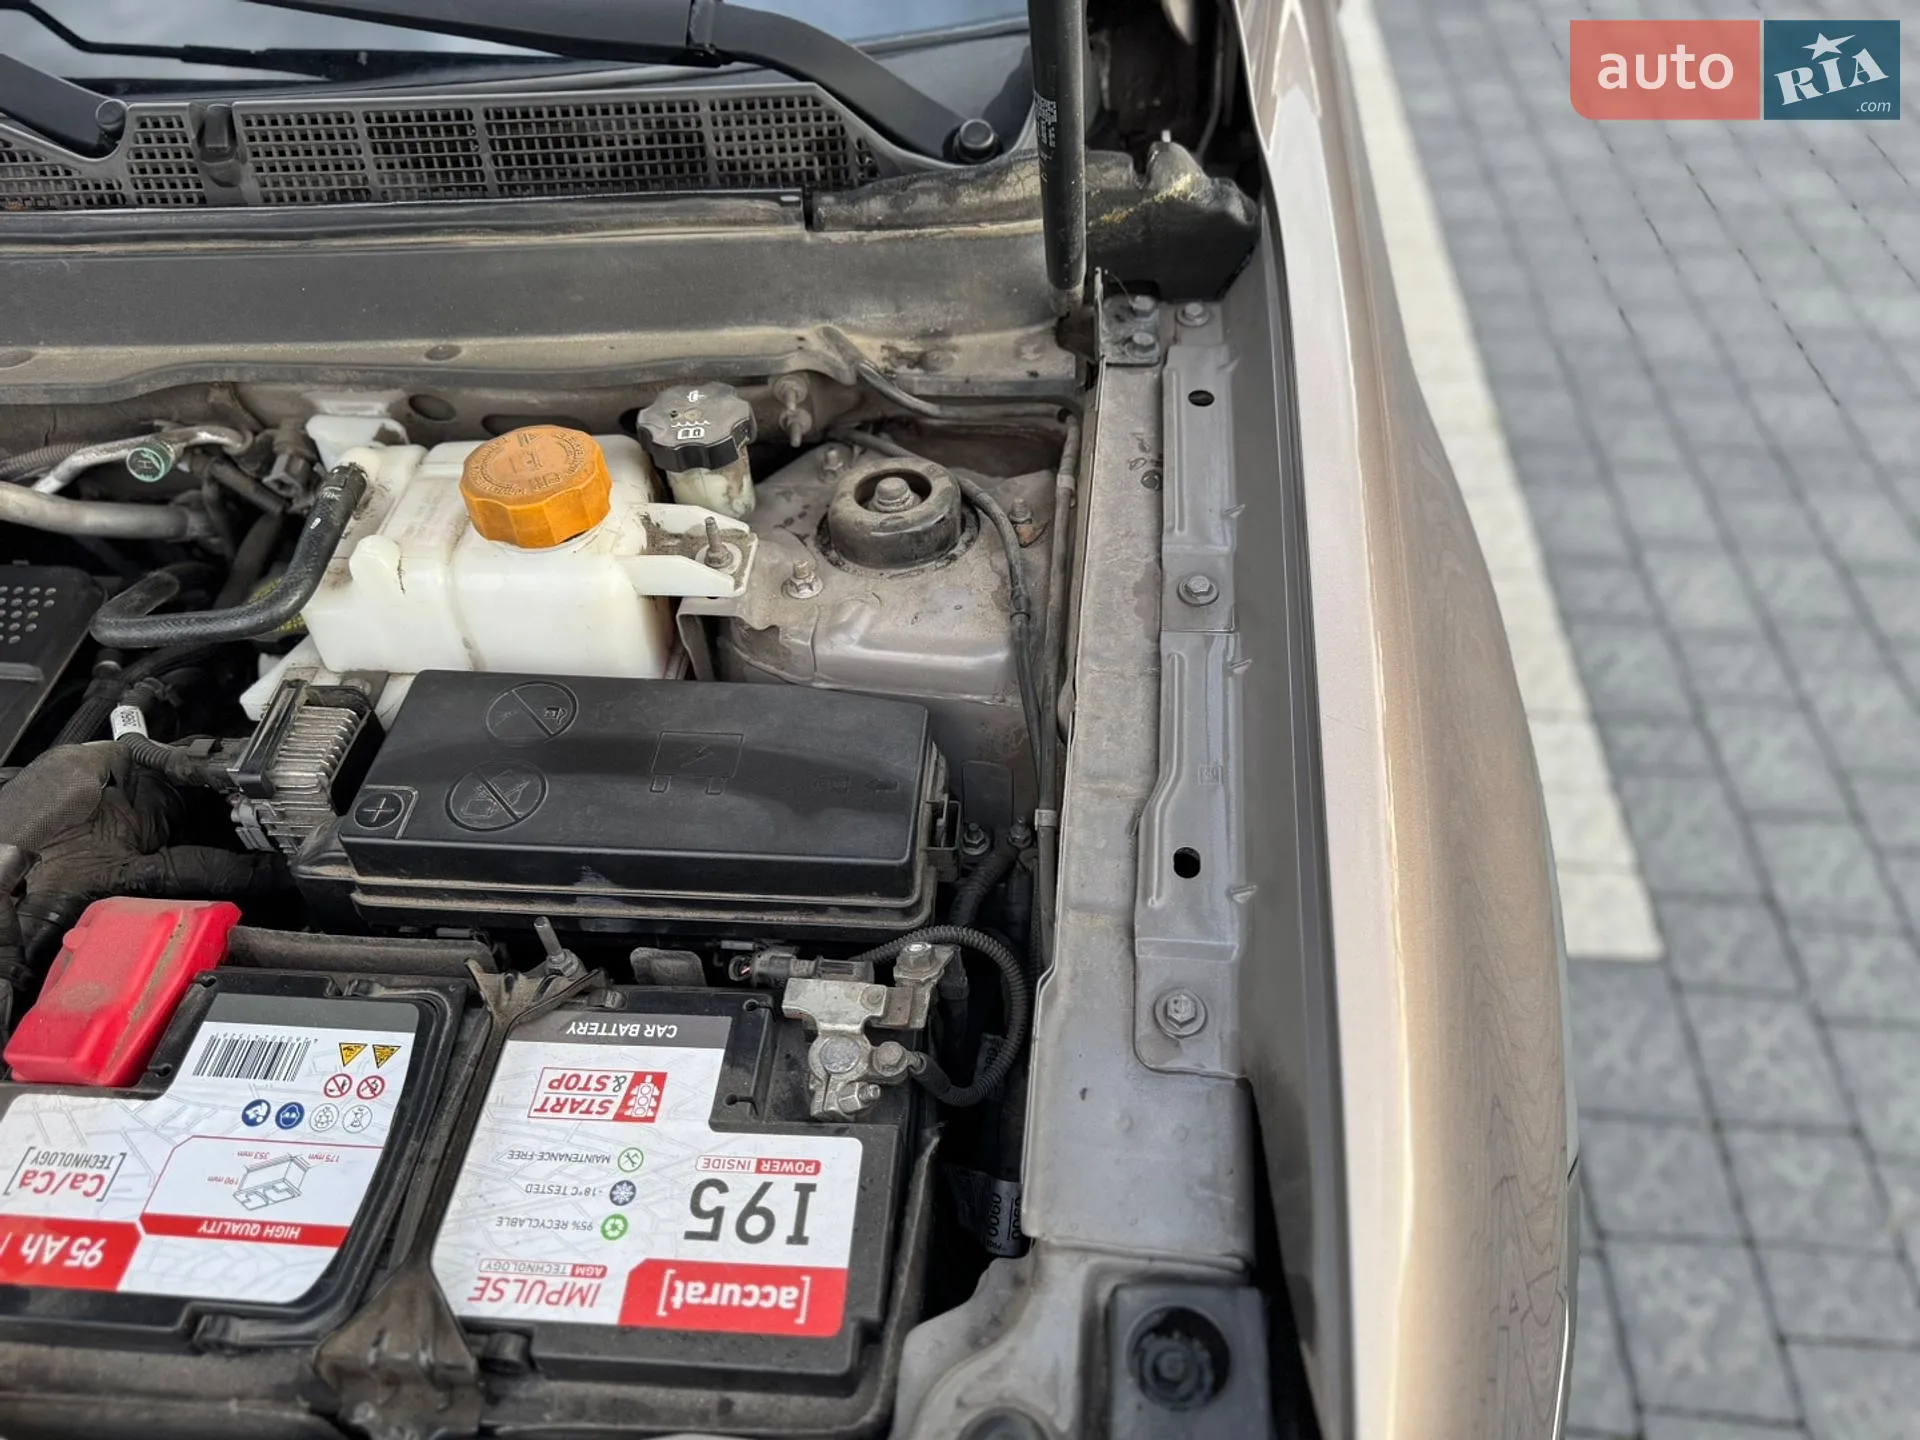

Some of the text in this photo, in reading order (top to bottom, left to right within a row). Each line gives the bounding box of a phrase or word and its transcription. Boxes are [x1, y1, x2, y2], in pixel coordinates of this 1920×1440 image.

[565, 1021, 678, 1038] CAR BATTERY
[533, 1096, 614, 1115] START
[30, 1150, 116, 1170] TECHNOLOGY
[237, 1151, 271, 1160] 353 mm
[308, 1153, 325, 1161] mm
[507, 1150, 611, 1164] MAINTENANCE-FREE
[702, 1158, 817, 1174] POWER INSIDE
[18, 1169, 106, 1198] Ca/Ca
[207, 1175, 224, 1183] mm
[525, 1183, 568, 1196] TESTED
[198, 1220, 301, 1240] HIGH QUALITY
[496, 1216, 593, 1231] 95% RECYCLABLE
[20, 1232, 70, 1265] Ah
[63, 1236, 107, 1269] 95
[485, 1261, 604, 1276] AGM TECHNOLOGY
[467, 1276, 603, 1309] IMPULSE
